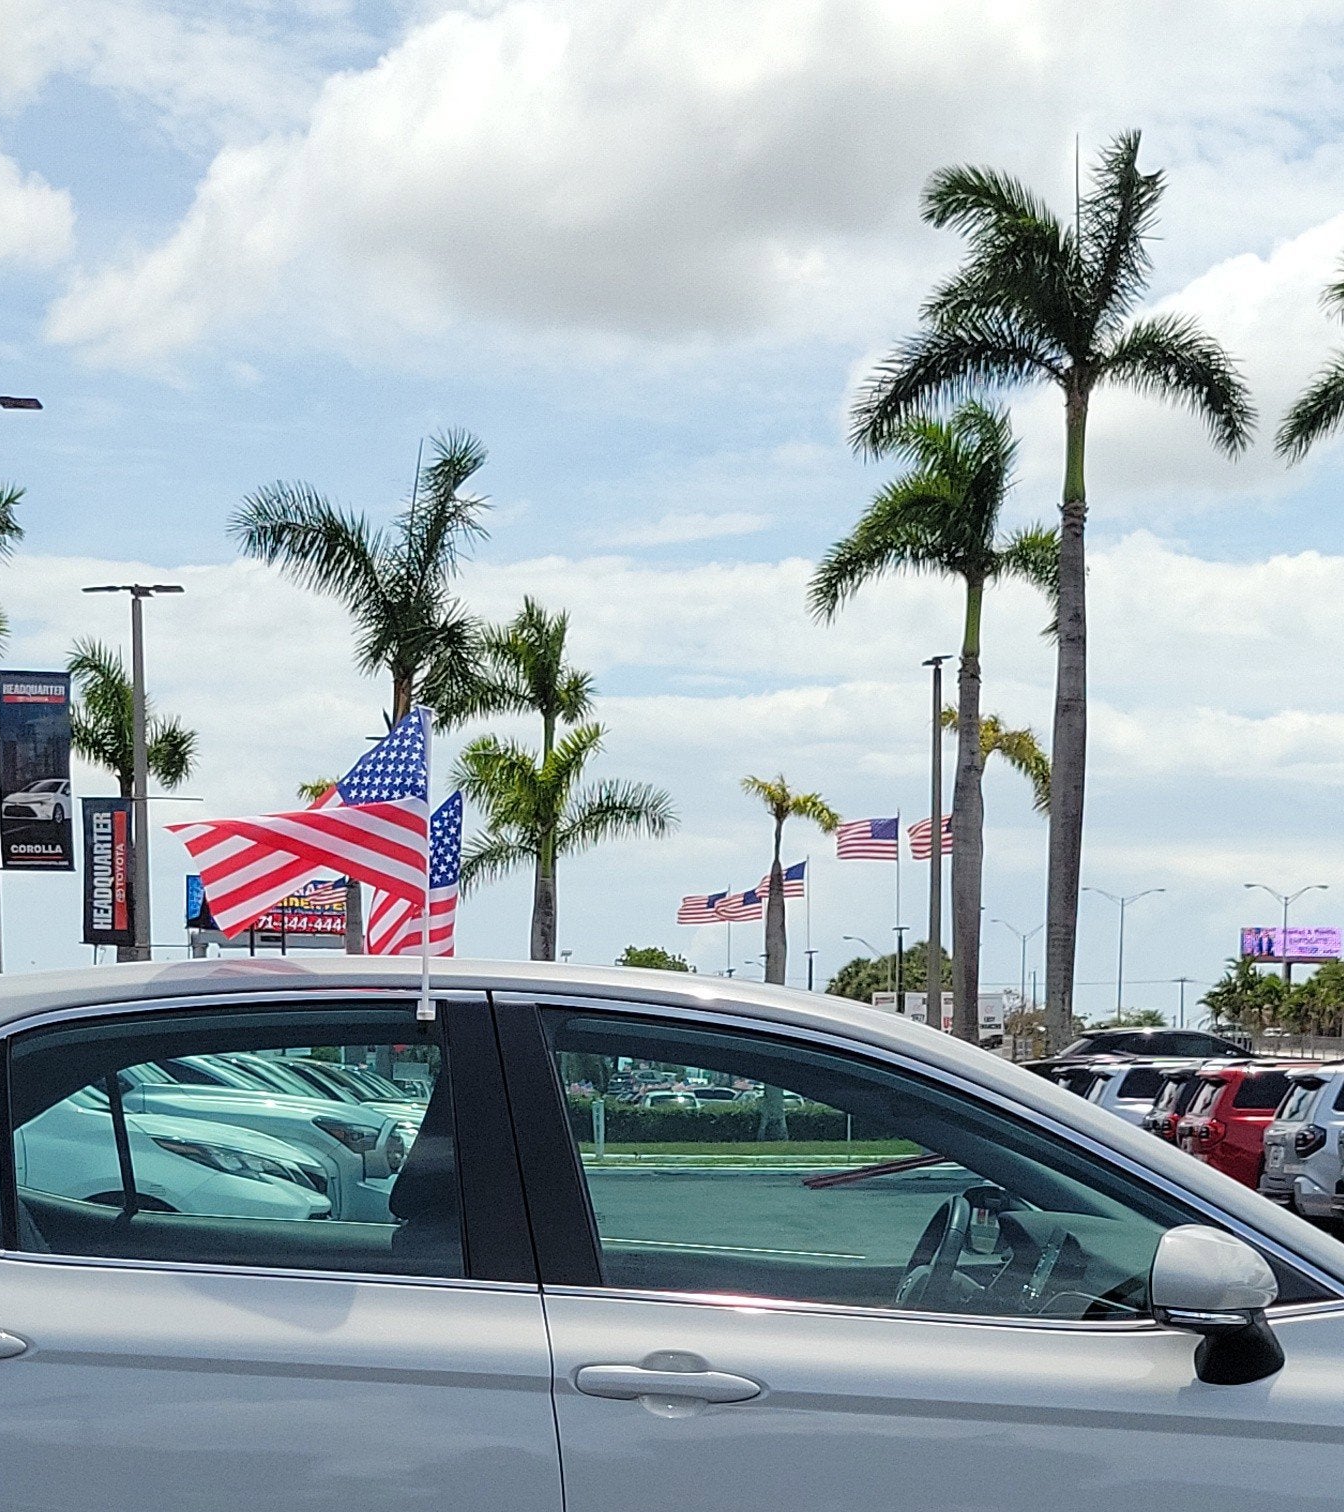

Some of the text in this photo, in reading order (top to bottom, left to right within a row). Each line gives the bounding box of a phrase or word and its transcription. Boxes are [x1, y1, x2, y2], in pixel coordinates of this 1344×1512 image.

[10, 844, 63, 854] COROLLA
[92, 811, 114, 930] HEADQUARTER
[115, 843, 126, 889] TOYOTA
